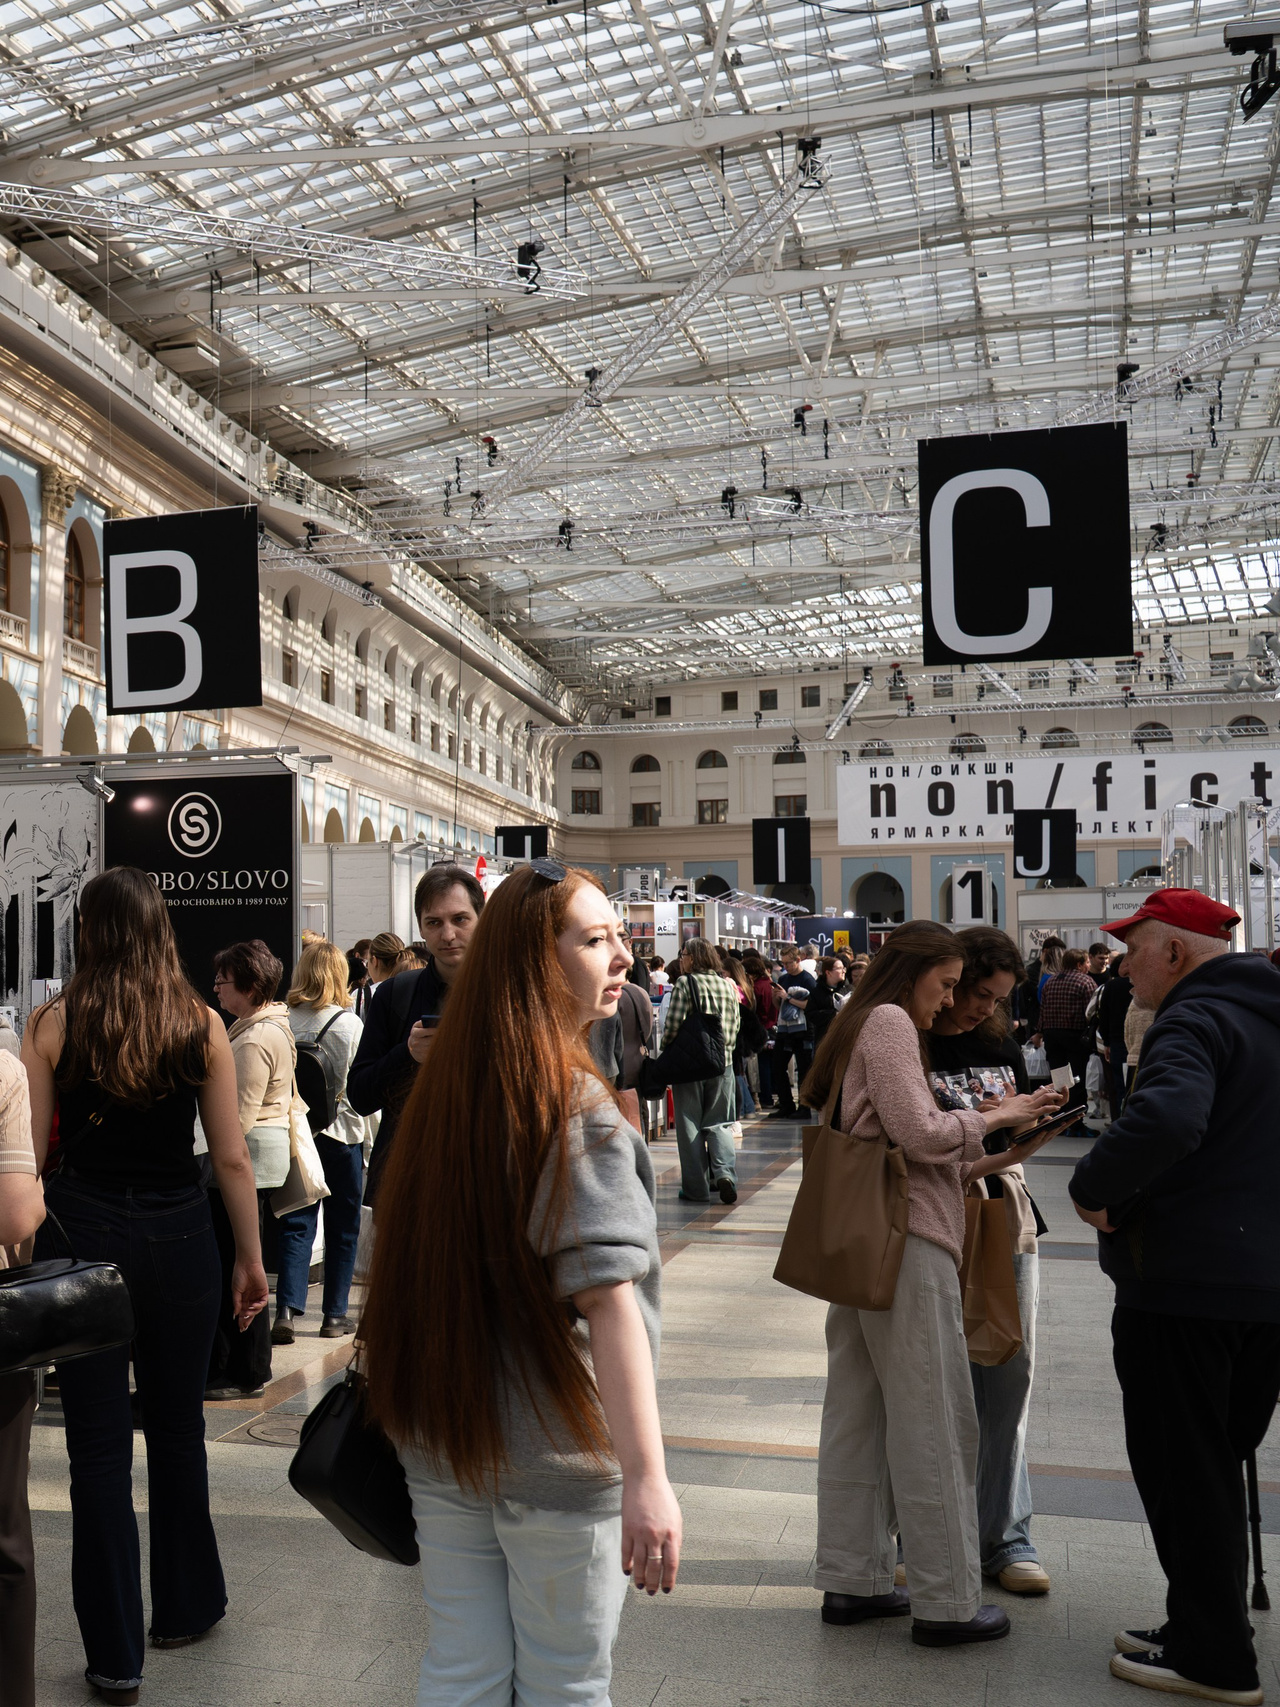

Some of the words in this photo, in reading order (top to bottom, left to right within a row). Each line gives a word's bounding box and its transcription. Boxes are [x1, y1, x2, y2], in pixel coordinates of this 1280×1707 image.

[929, 468, 1053, 656] C
[110, 550, 203, 708] B
[870, 762, 1014, 779] НОН/ФИКШН
[871, 825, 984, 839] ЯРМАРКА
[1016, 819, 1050, 877] J
[182, 898, 235, 906] ОСНОВАНО
[237, 897, 243, 905] В
[245, 897, 263, 905] 1989
[265, 897, 289, 906] ГОДУ
[957, 870, 984, 919] 1
